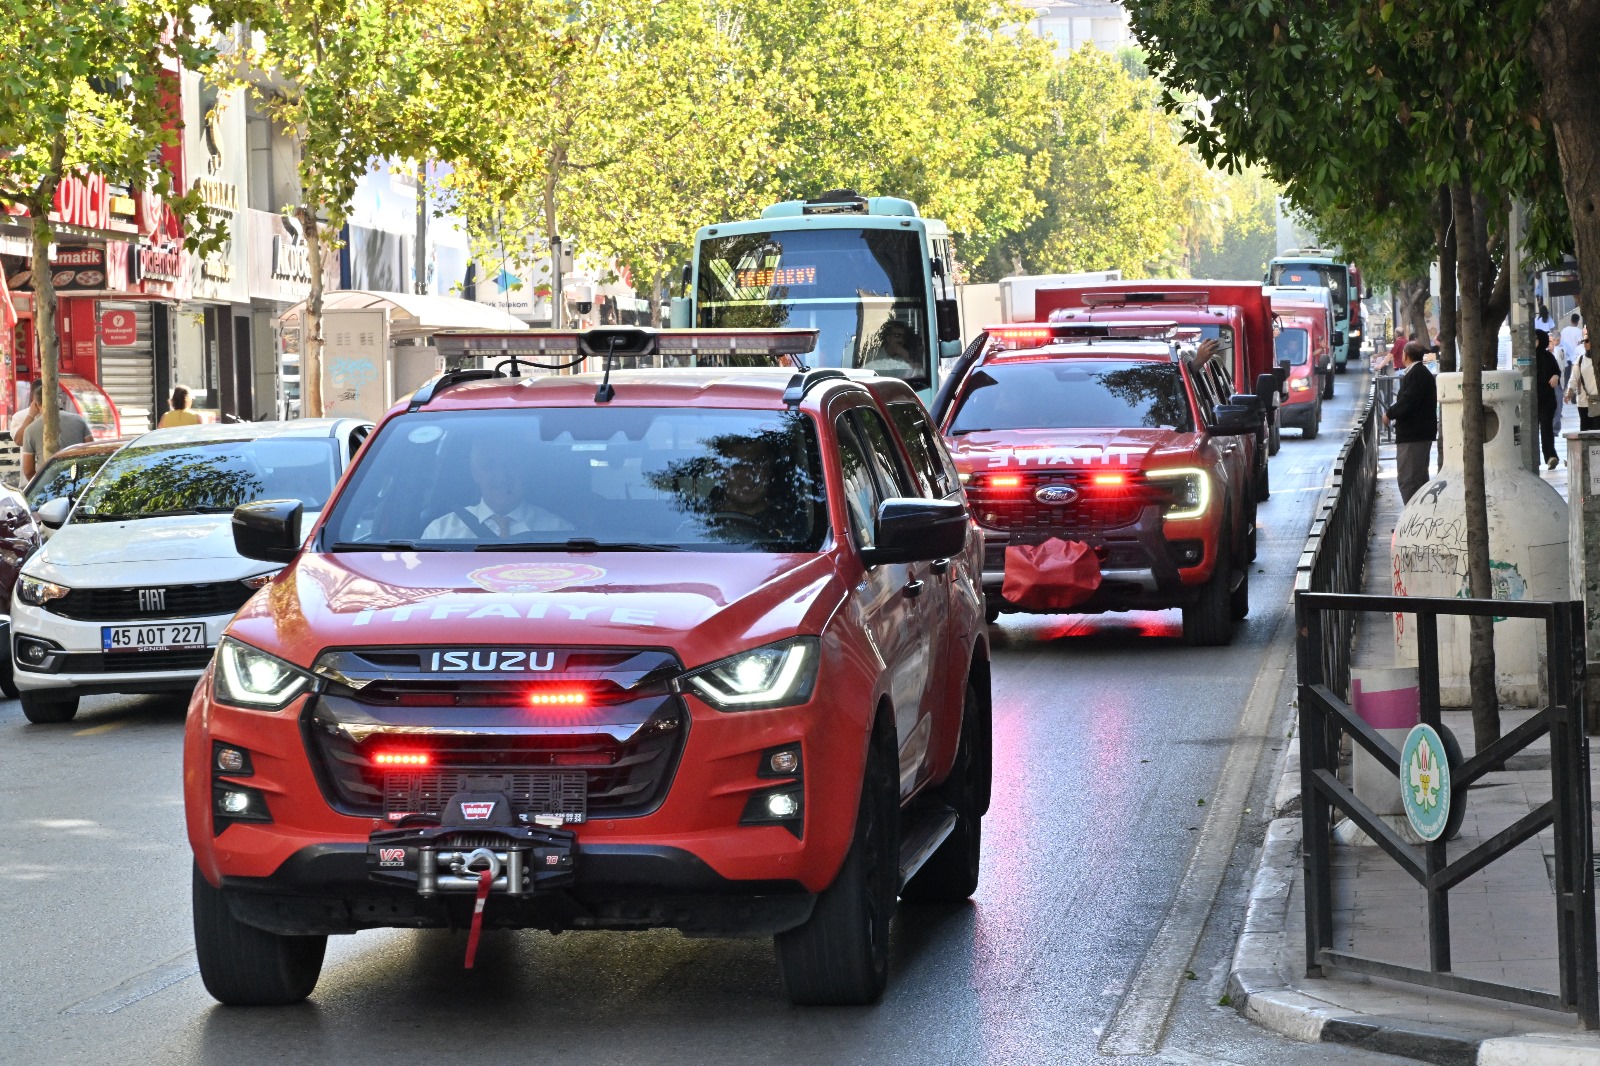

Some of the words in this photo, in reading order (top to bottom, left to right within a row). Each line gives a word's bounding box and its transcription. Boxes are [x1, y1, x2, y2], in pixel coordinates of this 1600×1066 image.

[1044, 490, 1068, 501] Ford
[138, 588, 166, 611] FIAT
[112, 629, 131, 645] 45
[137, 627, 166, 645] AOT
[171, 626, 201, 643] 227
[431, 651, 555, 671] ISUZU
[380, 849, 405, 861] VR
